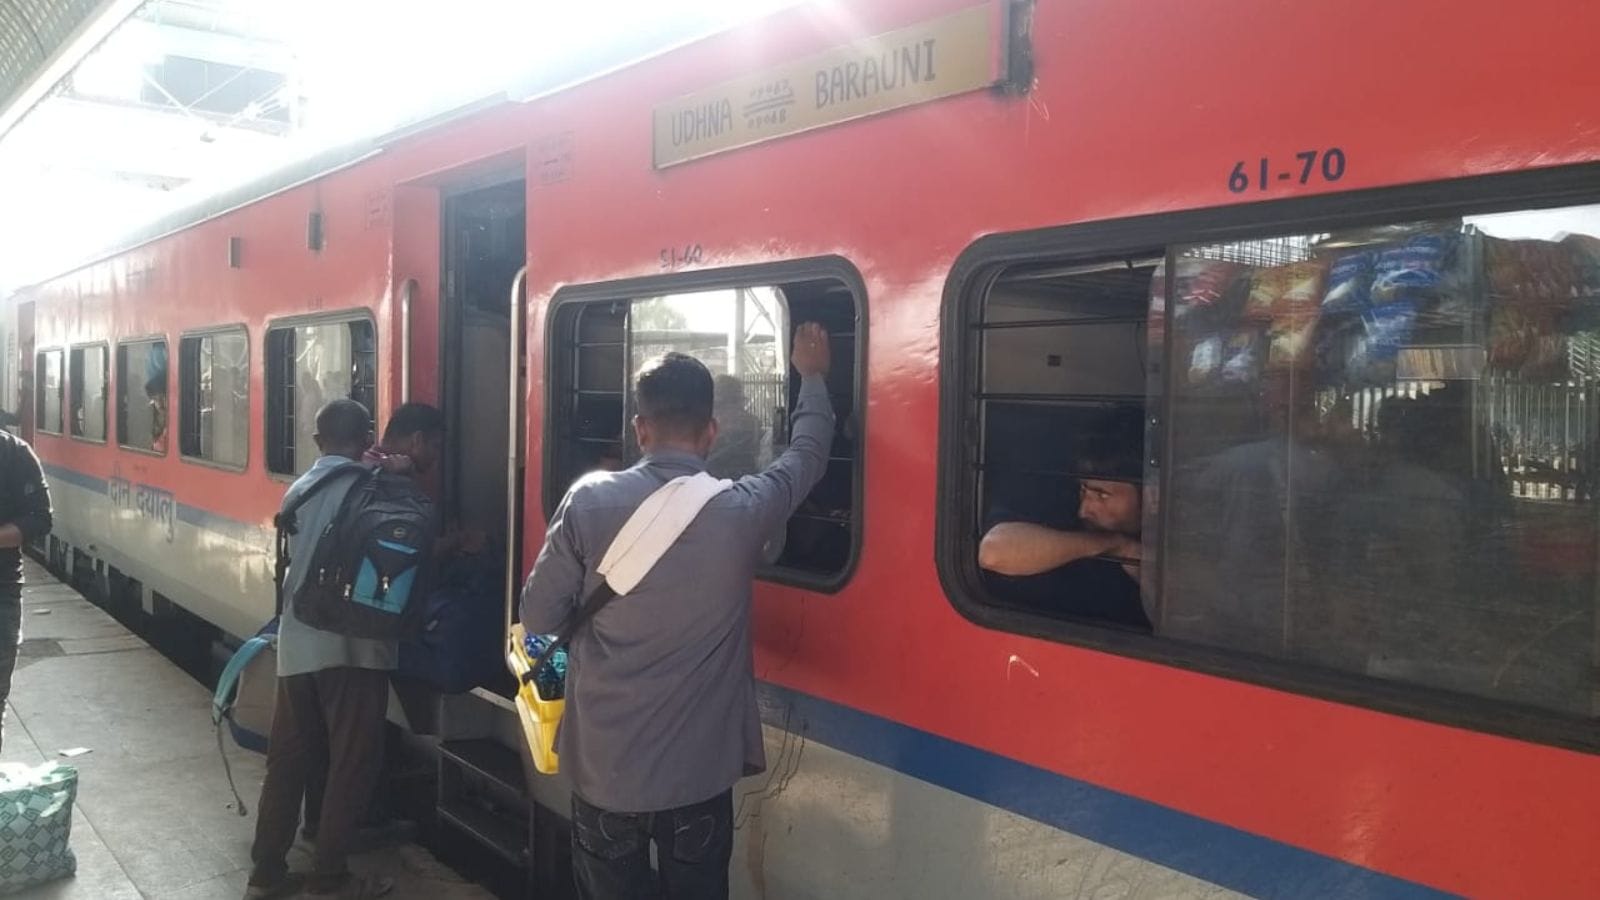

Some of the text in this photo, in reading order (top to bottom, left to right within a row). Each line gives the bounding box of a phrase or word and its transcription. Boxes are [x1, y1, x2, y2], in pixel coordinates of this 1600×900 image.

[671, 38, 936, 147] UDHNA BARAUNI
[1228, 147, 1346, 194] 61-70
[660, 243, 703, 268] 51-60
[109, 461, 174, 543] दीन दयालु
